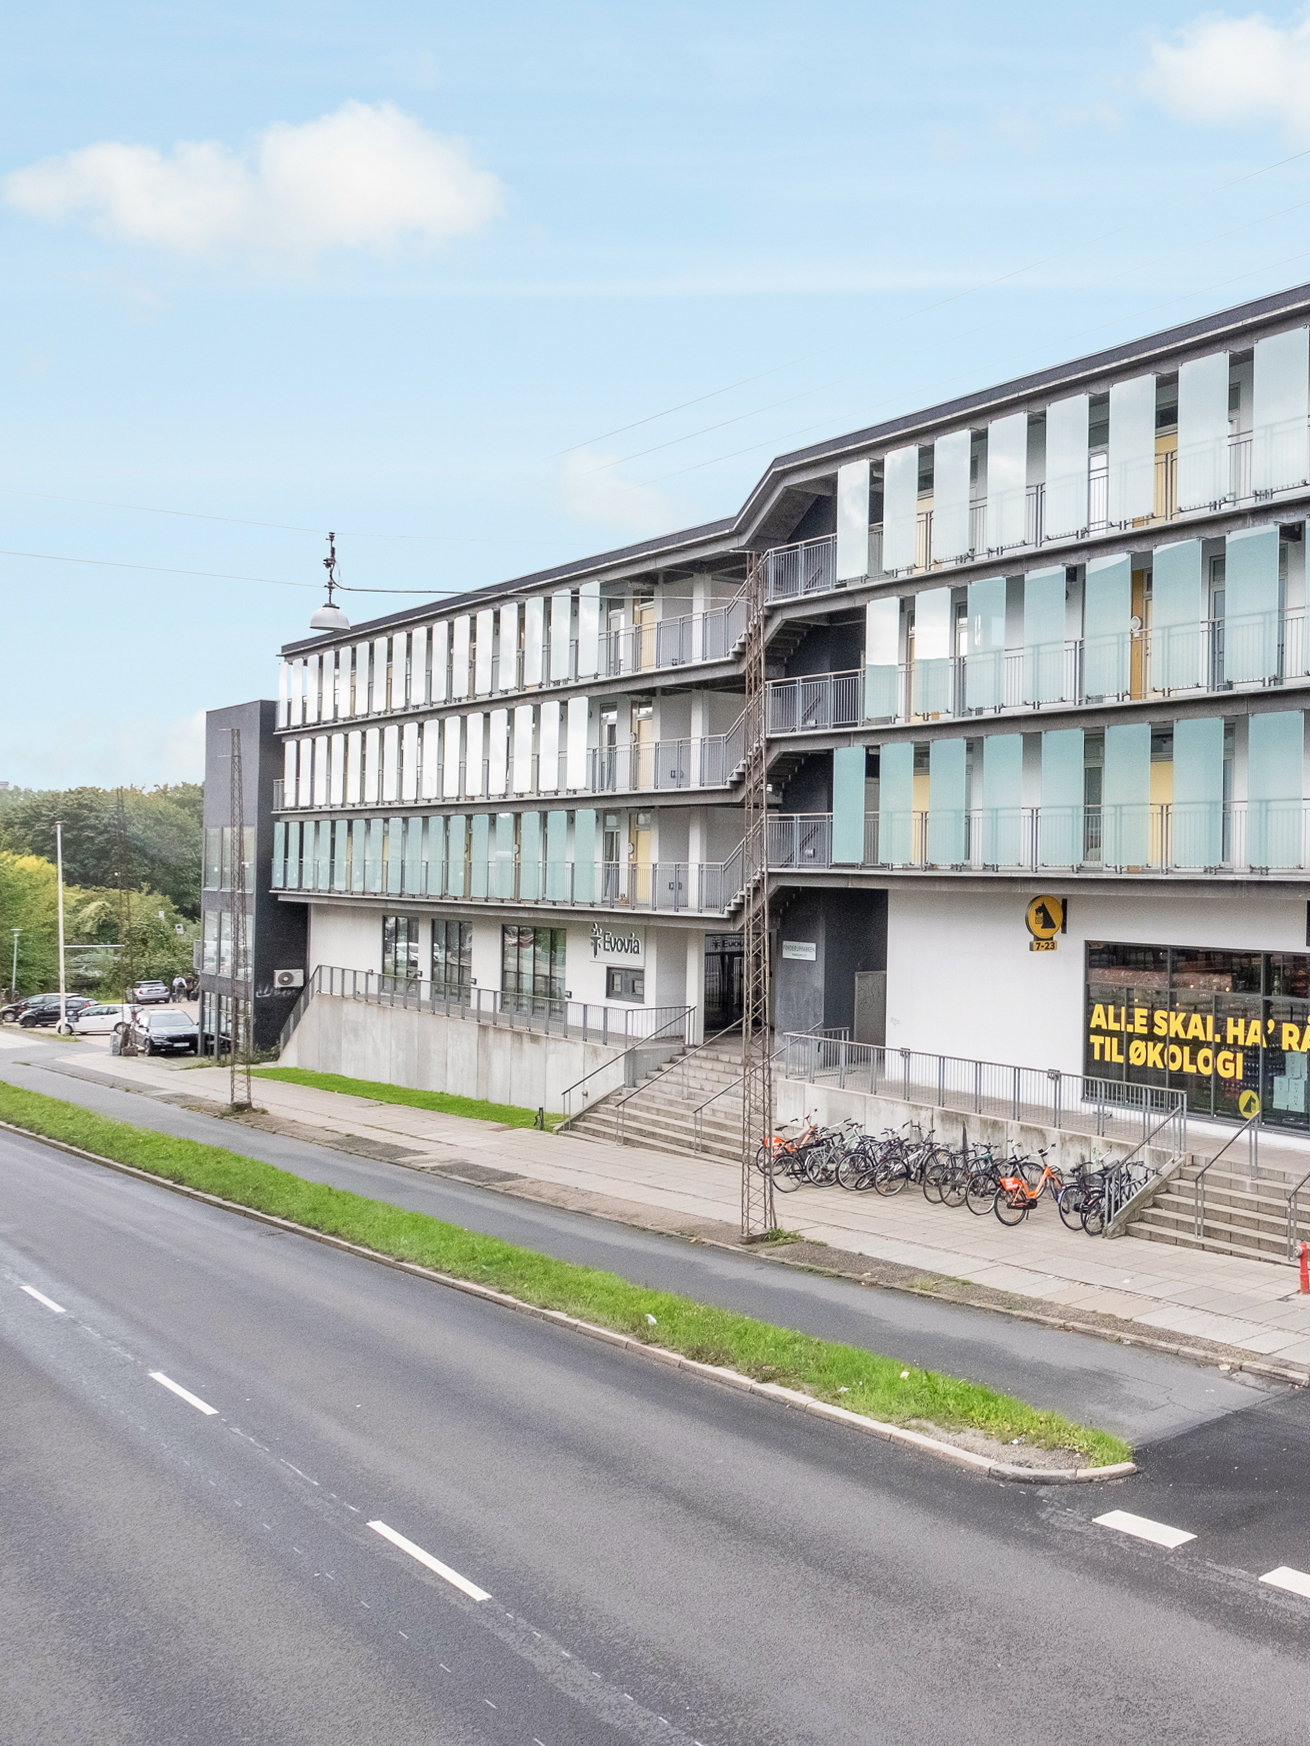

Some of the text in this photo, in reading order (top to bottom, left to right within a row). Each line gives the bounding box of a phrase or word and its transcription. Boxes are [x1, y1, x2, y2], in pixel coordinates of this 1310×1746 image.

[603, 931, 641, 954] Evovia
[1035, 942, 1055, 950] 7-23
[1090, 1003, 1148, 1034] ALLE
[1153, 1010, 1220, 1042] SKAL
[1090, 1035, 1244, 1080] TIL ØKOLOGI
